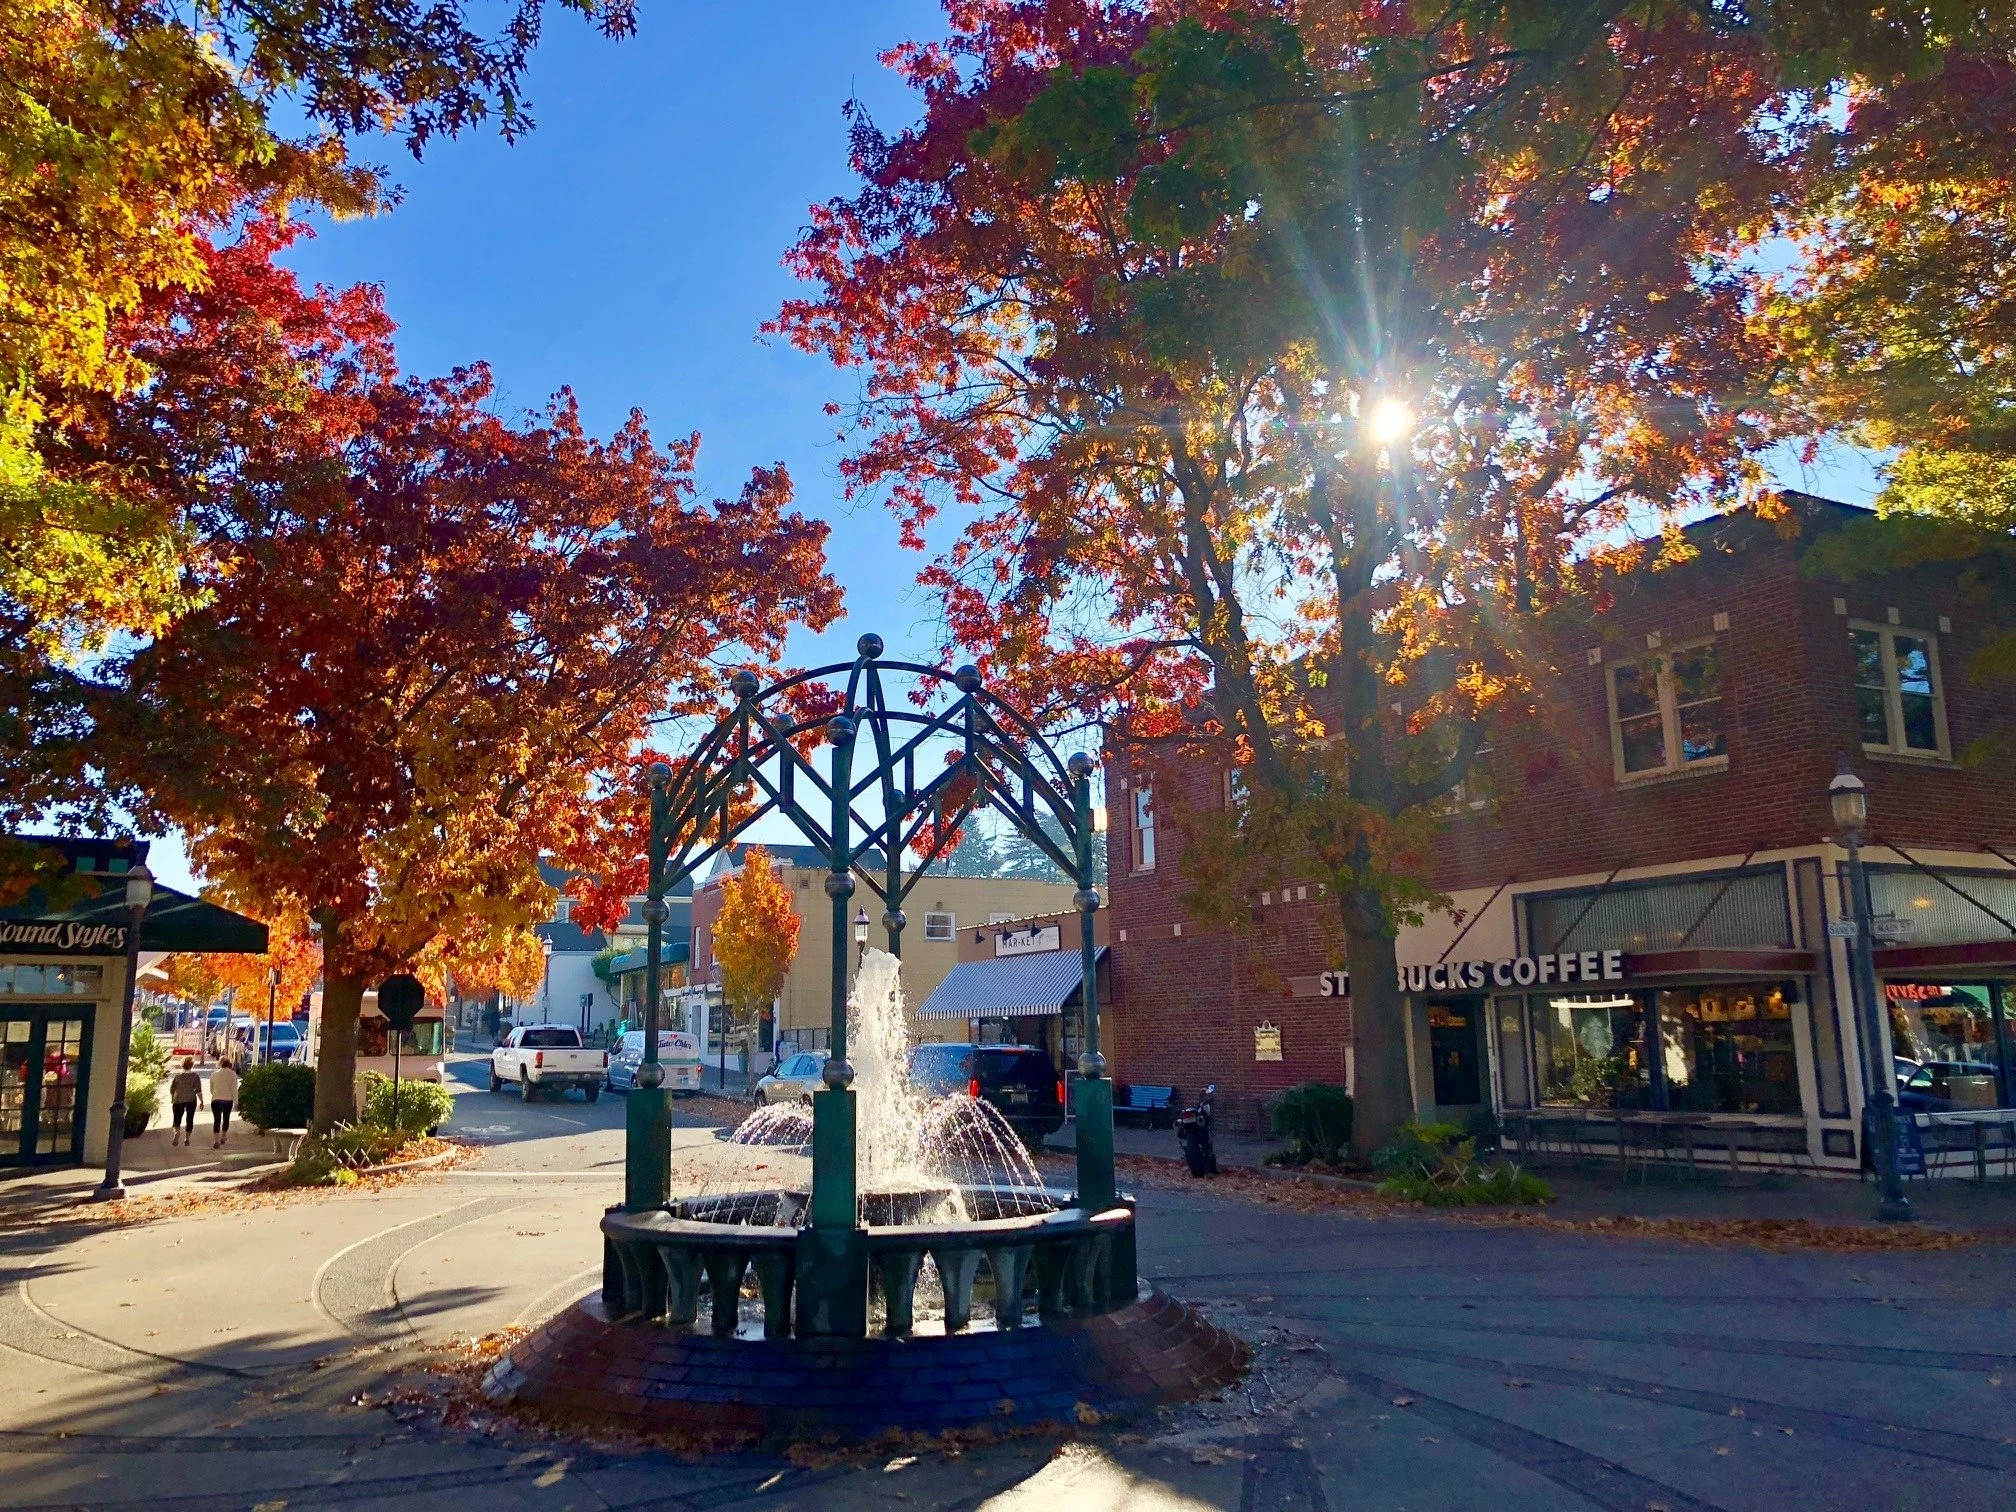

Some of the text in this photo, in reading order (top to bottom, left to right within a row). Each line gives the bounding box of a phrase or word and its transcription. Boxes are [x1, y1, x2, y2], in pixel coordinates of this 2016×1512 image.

[58, 922, 127, 949] Styles
[1878, 923, 1898, 932] MAIN
[1319, 949, 1623, 997] STBUCKS COFFEE
